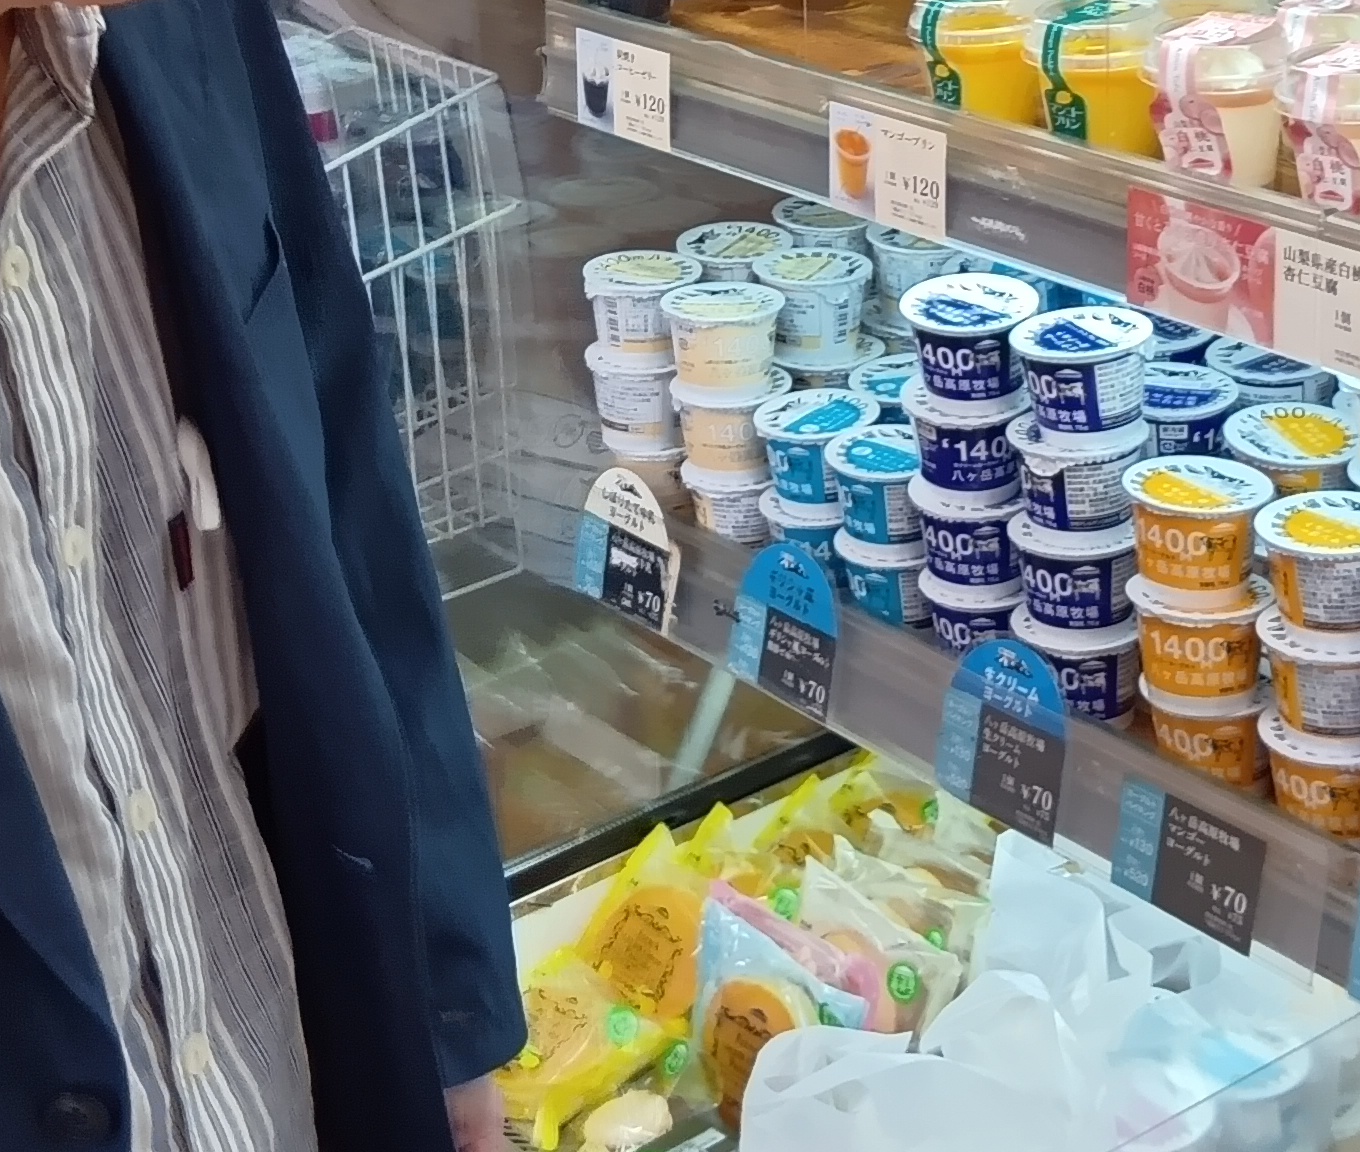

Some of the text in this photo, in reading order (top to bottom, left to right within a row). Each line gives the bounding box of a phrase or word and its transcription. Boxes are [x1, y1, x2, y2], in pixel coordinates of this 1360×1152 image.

[635, 93, 665, 115] ¥120
[880, 128, 935, 151] マンゴープリン
[902, 175, 940, 200] ¥120
[1283, 264, 1339, 297] 杏仁豆腐
[636, 590, 661, 614] ¥70
[798, 678, 826, 705] ¥70
[984, 665, 1041, 704] 生クリーム
[982, 686, 1034, 719] ヨーグルト
[1019, 783, 1053, 812] ¥70
[1168, 822, 1206, 846] マンゴー
[1210, 882, 1249, 914] ¥70
